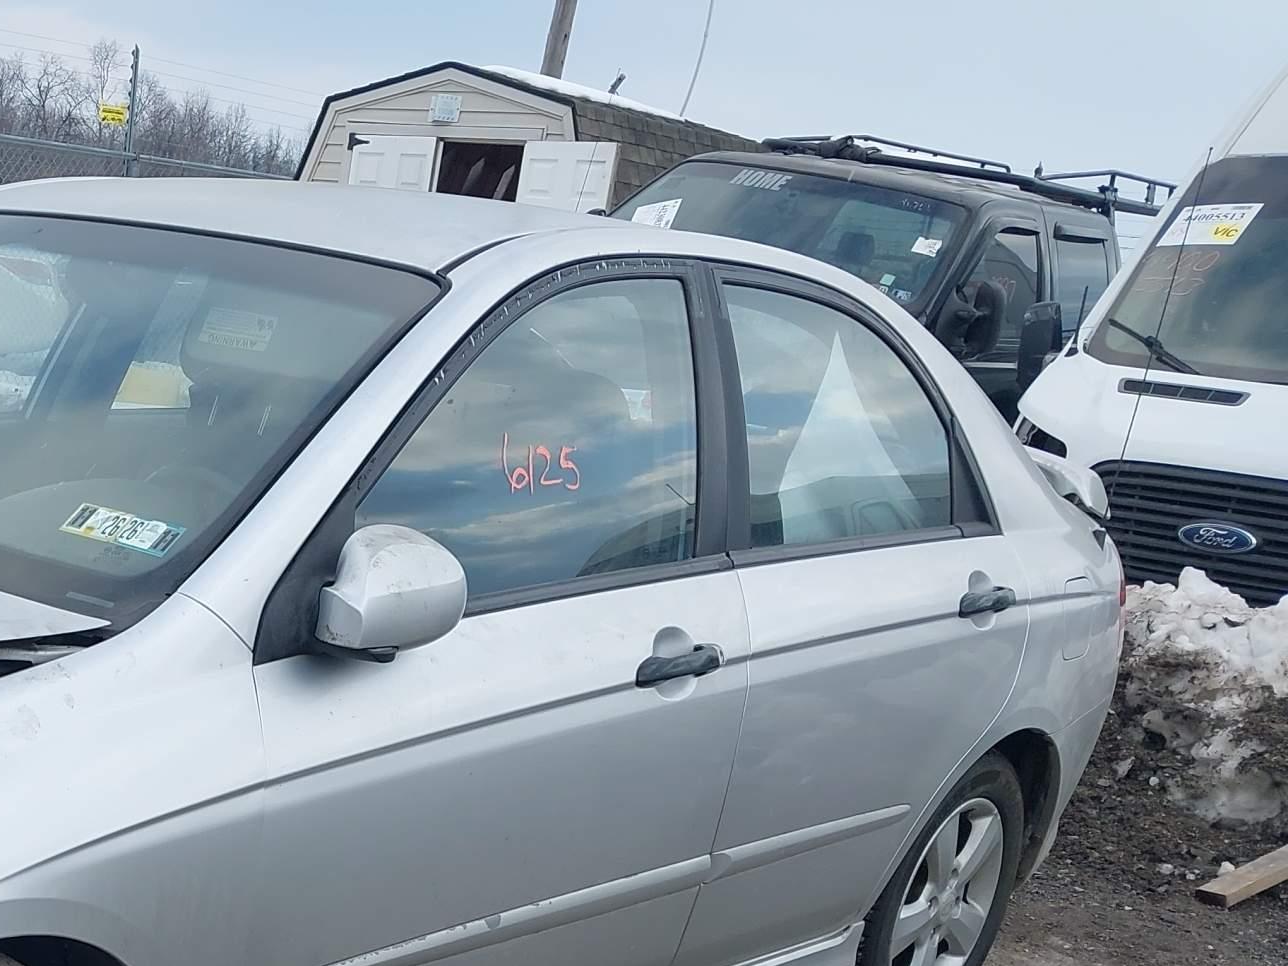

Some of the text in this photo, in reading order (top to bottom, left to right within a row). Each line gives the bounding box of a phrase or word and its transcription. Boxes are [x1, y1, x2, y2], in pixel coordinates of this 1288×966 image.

[729, 168, 793, 191] HOME
[1213, 226, 1238, 238] VIC
[501, 431, 580, 496] 6125
[100, 515, 127, 538] 26
[119, 519, 145, 541] 26
[1193, 527, 1238, 548] Ford
